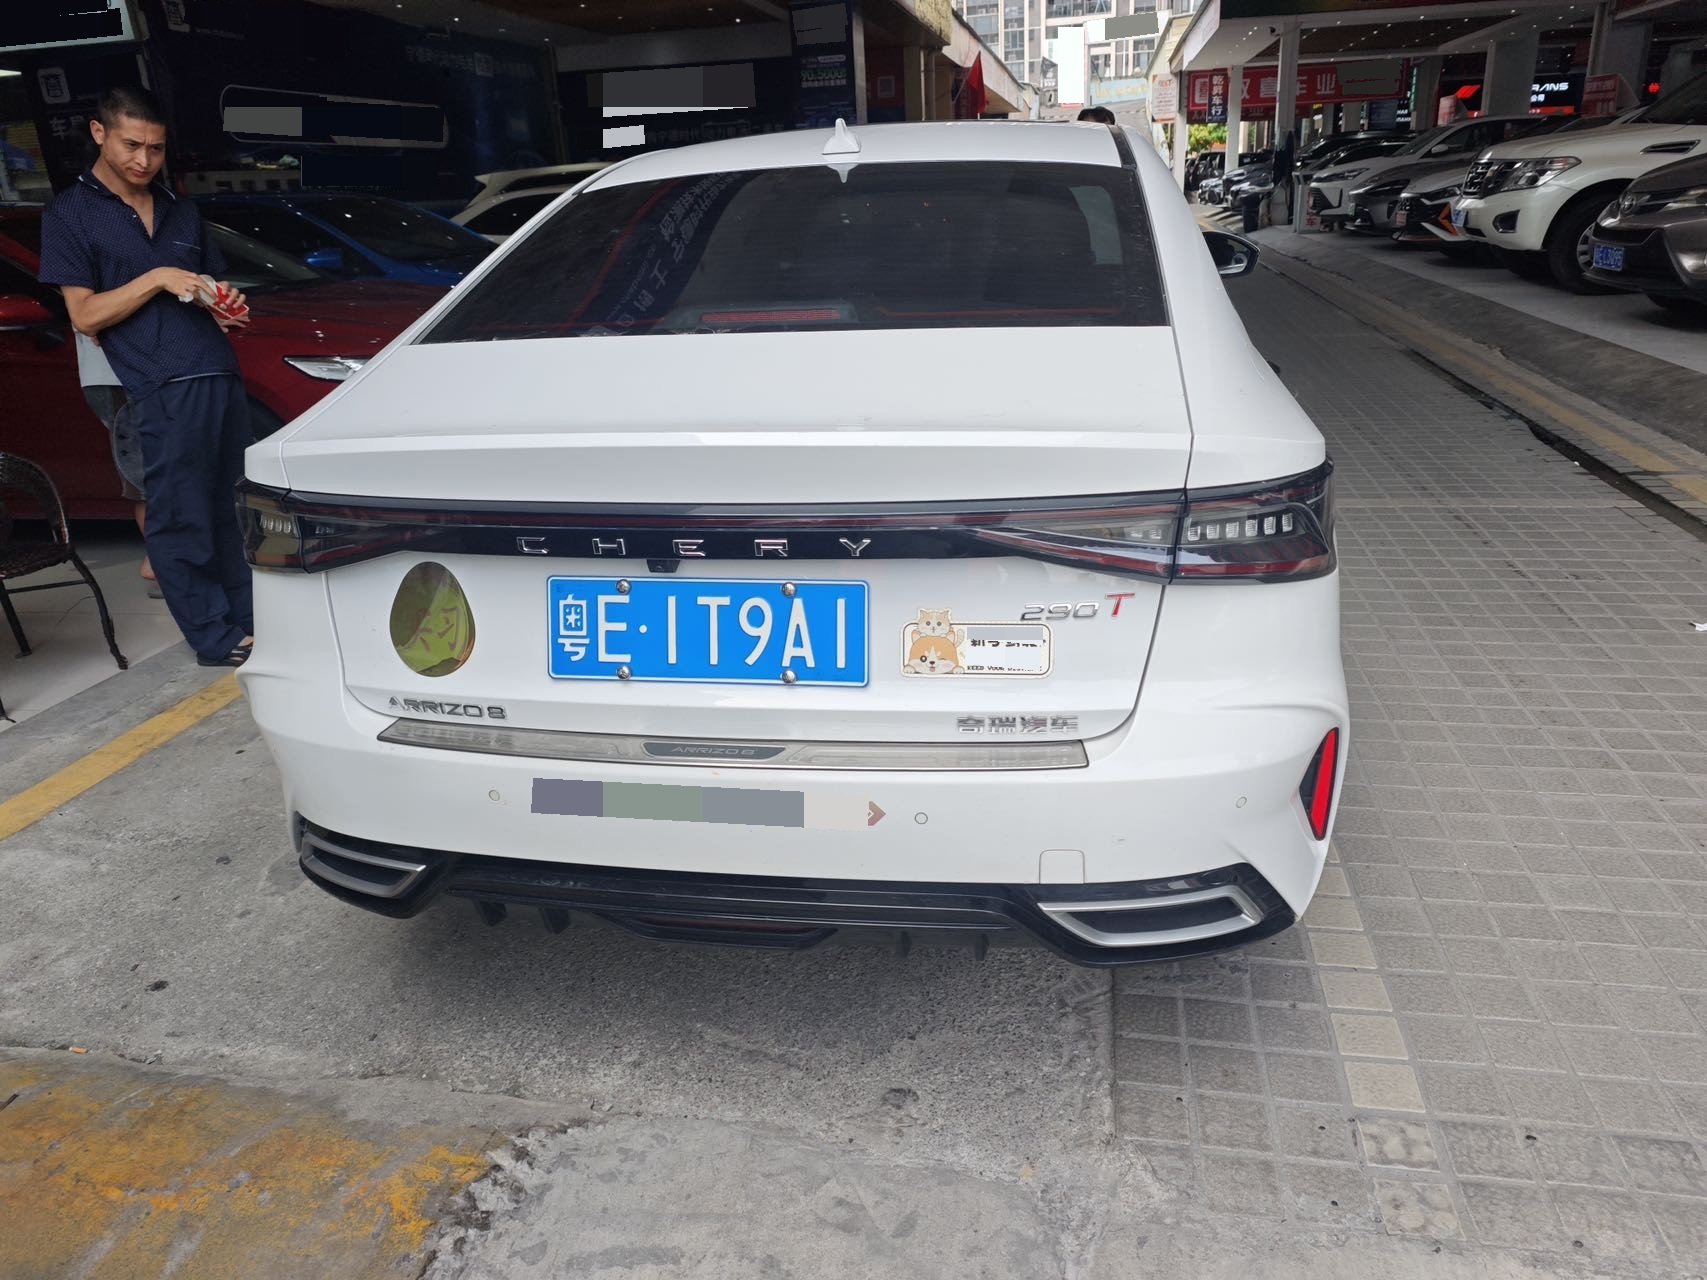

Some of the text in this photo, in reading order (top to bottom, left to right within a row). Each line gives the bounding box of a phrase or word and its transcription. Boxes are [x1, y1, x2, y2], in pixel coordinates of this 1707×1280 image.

[516, 536, 871, 557] CHERY
[956, 715, 1079, 734] 奇瑞汽车
